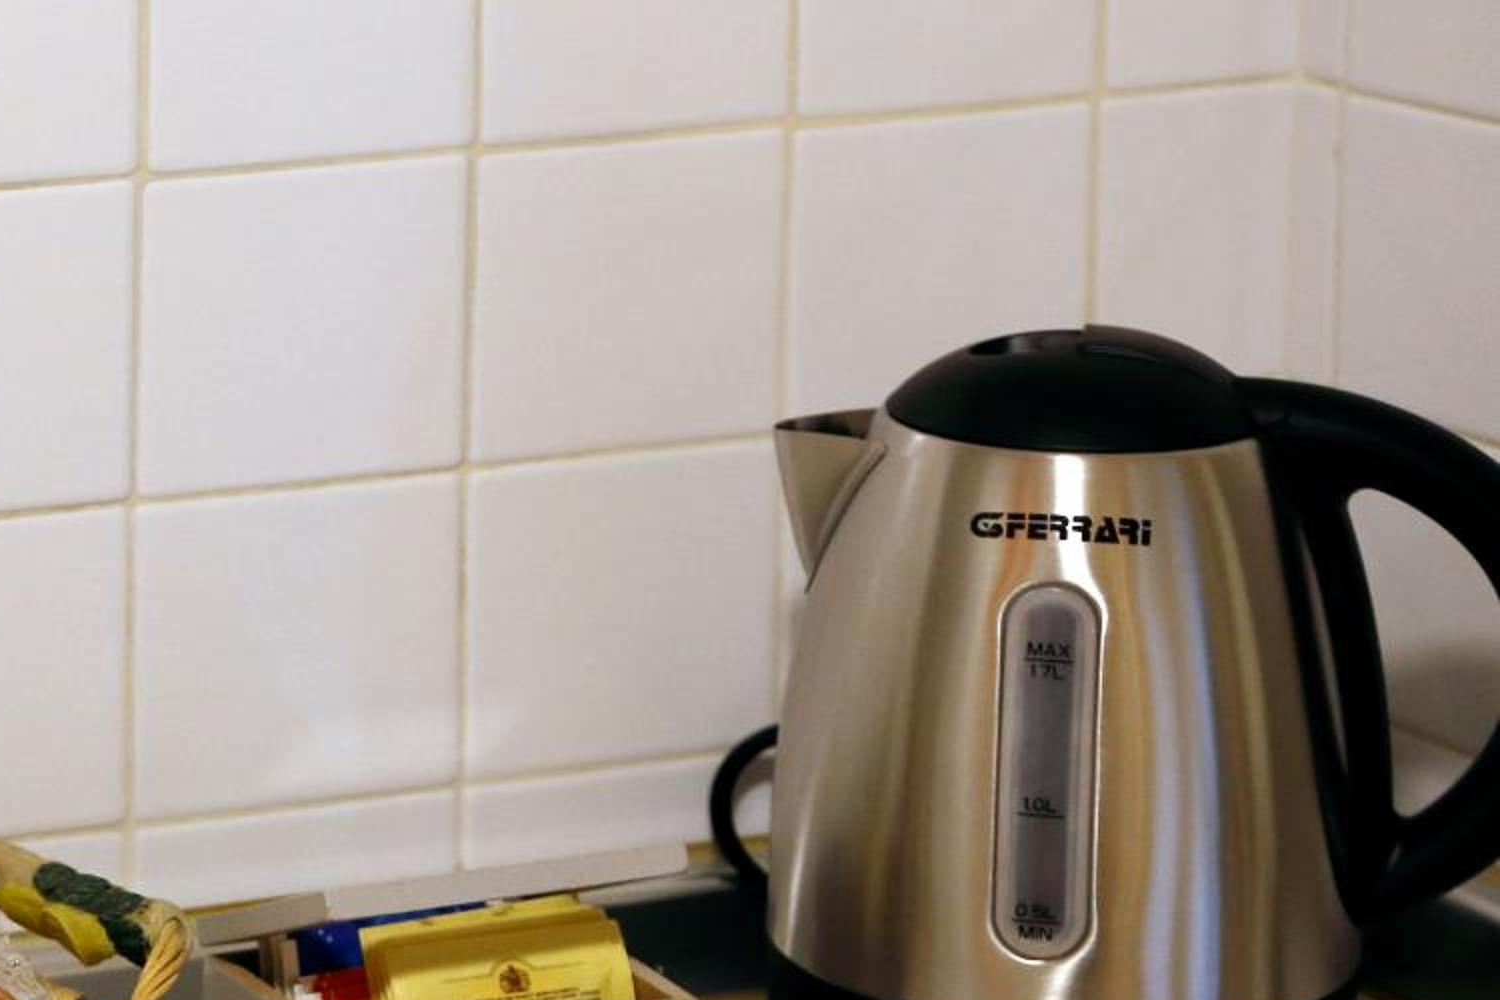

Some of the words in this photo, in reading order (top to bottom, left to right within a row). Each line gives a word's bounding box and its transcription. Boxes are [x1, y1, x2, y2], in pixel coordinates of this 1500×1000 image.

[1026, 641, 1072, 659] MAX
[1030, 664, 1065, 681] 17L
[1017, 926, 1054, 942] MIN
